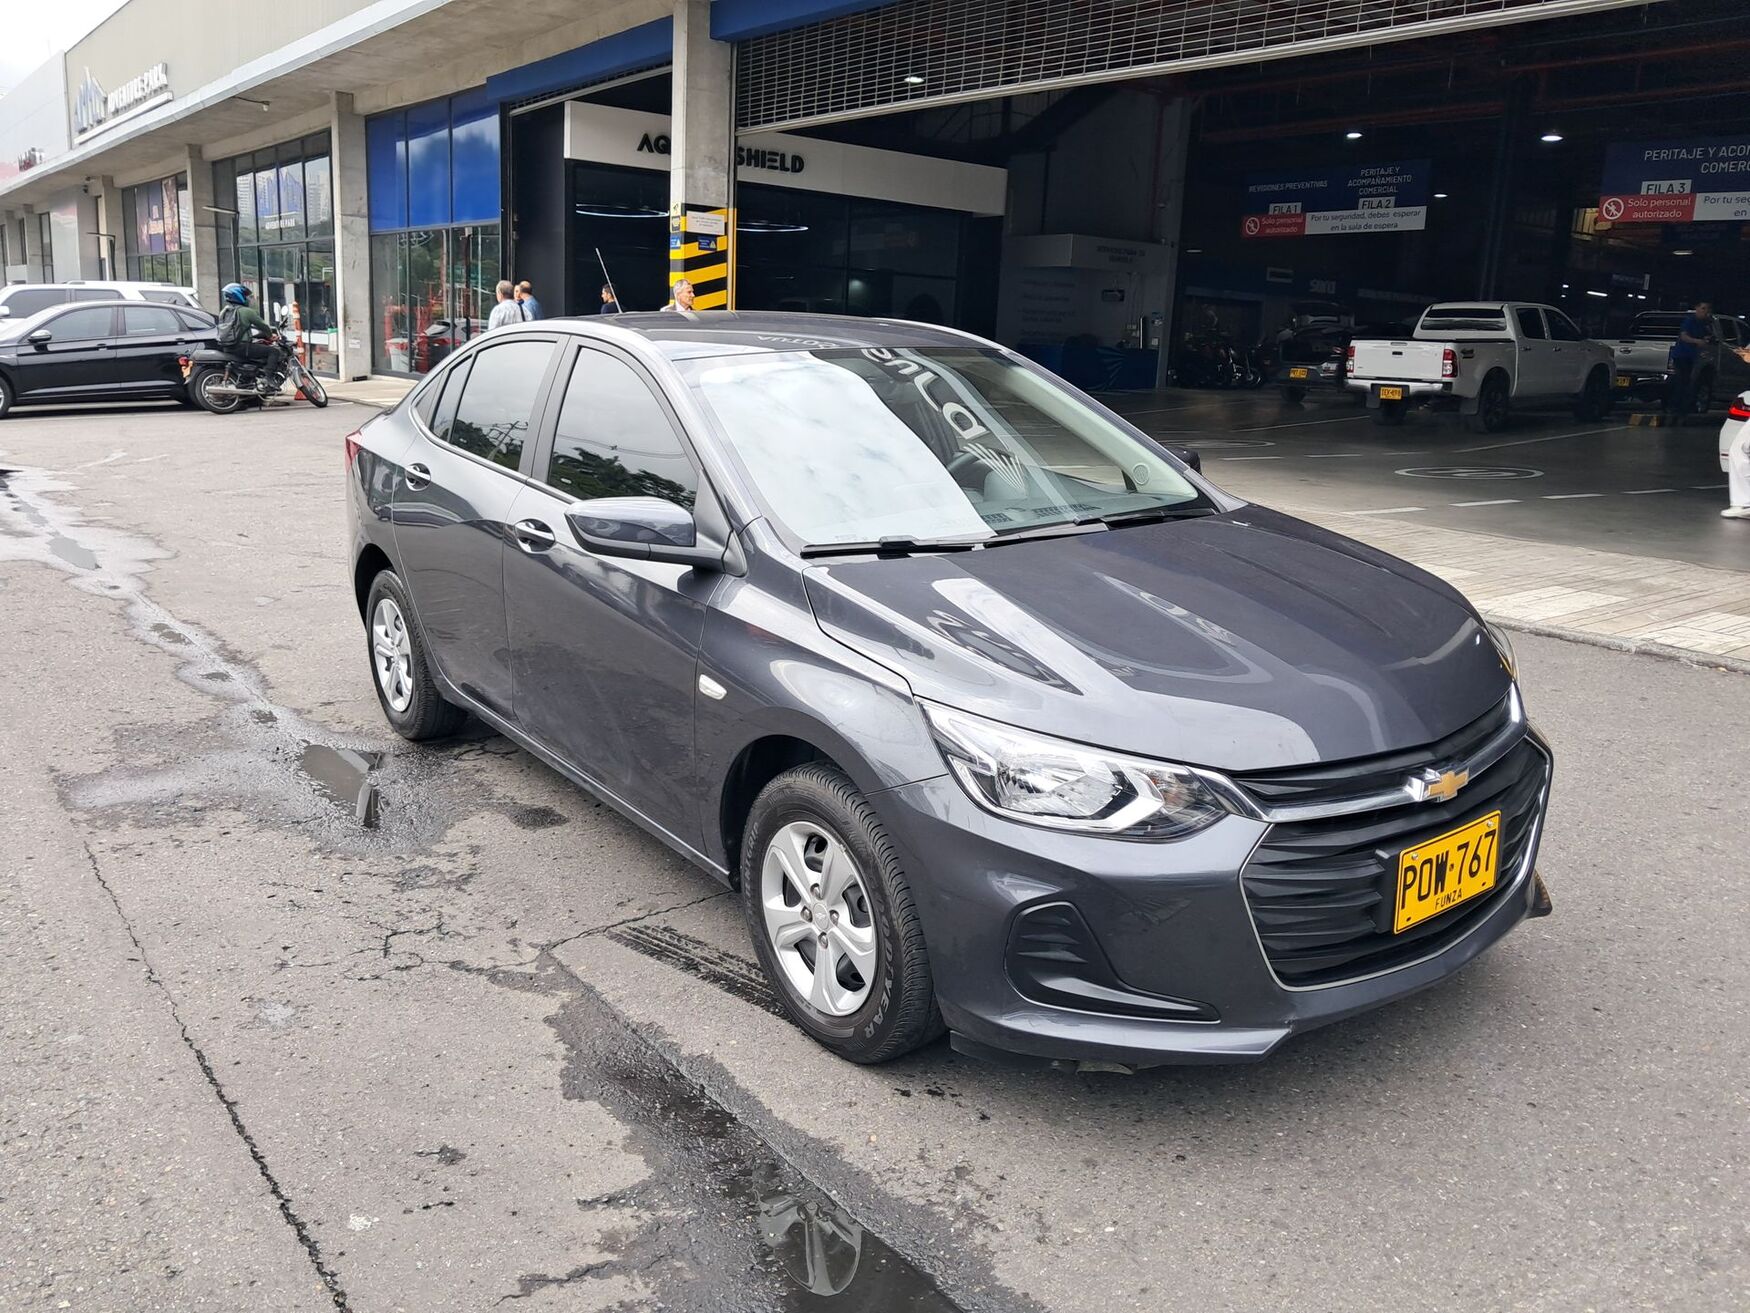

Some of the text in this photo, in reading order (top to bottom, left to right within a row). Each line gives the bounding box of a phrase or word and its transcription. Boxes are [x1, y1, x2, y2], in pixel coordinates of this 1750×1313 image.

[1645, 148, 1705, 160] PERITAJE
[1708, 146, 1717, 158] Y
[737, 145, 805, 174] SHIELD
[1360, 167, 1394, 176] PERITAJE
[1348, 175, 1412, 187] ACOMPAÑAMIENTO
[1359, 185, 1398, 195] COMERCIAL
[1646, 182, 1685, 194] FILA 3
[1362, 199, 1391, 209] FILA 2
[1628, 197, 1691, 208] Solo personal
[1704, 195, 1720, 204] Por
[1722, 196, 1733, 204] tu
[1273, 204, 1291, 214] FILA
[1393, 210, 1421, 218] esperar
[1633, 209, 1682, 218] autorizado
[1734, 209, 1747, 217] en
[1262, 217, 1275, 225] Solo
[1374, 222, 1398, 230] espera
[1435, 888, 1463, 910] FUNZA
